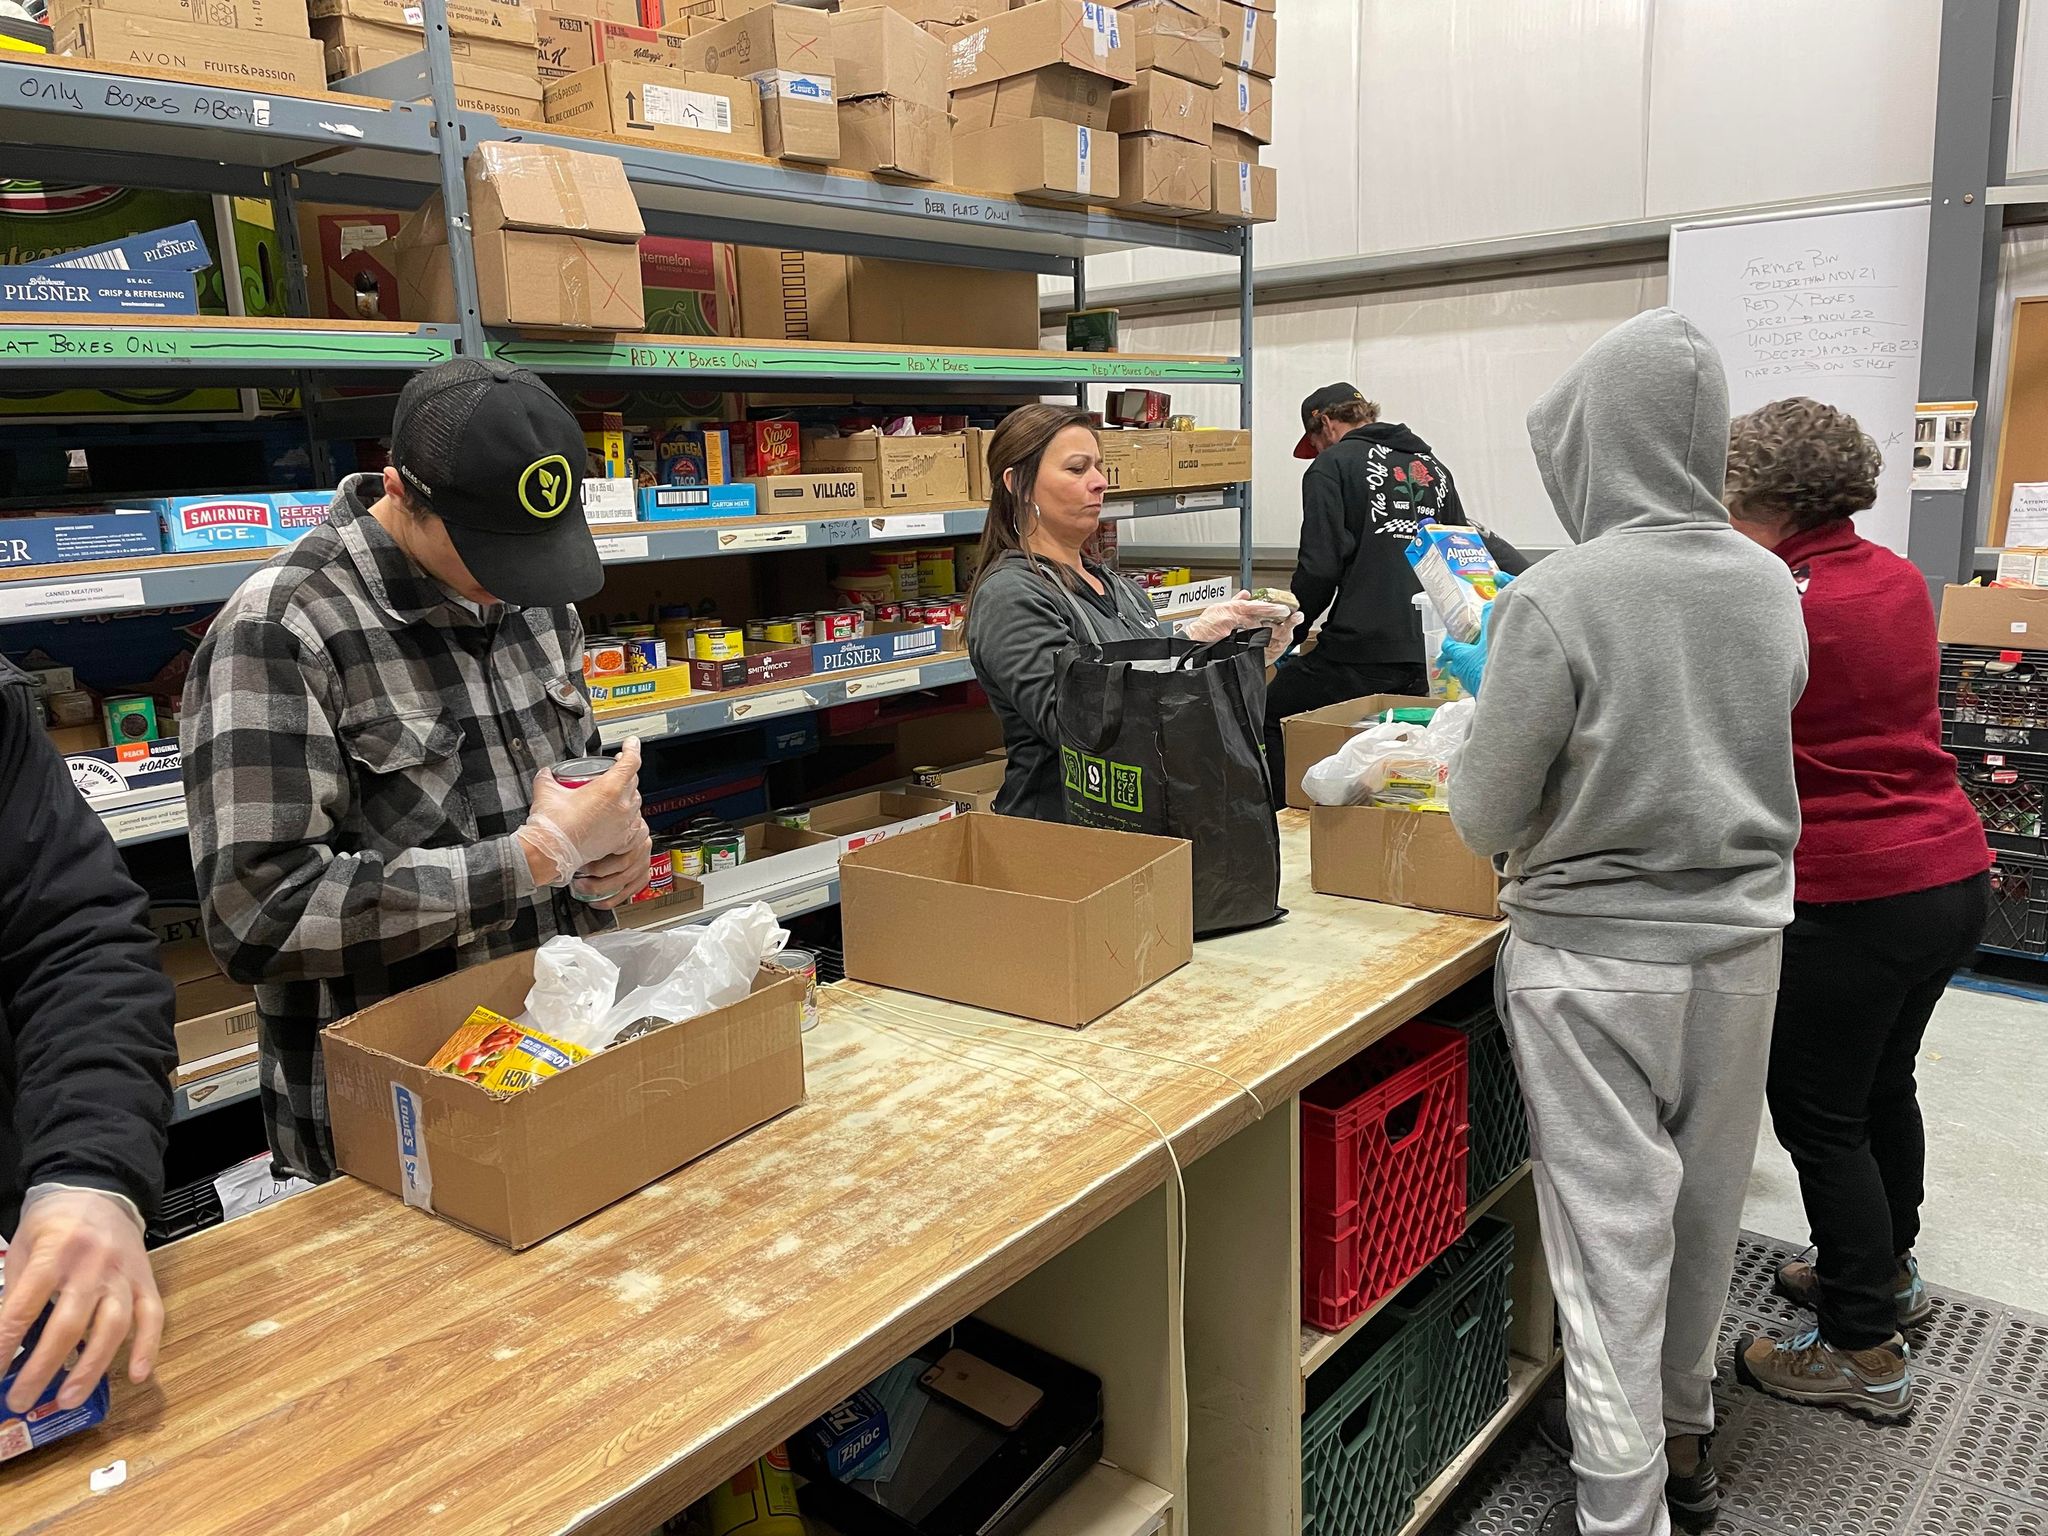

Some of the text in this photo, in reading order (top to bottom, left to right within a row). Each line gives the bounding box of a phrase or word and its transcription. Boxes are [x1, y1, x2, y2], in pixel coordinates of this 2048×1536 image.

[456, 13, 489, 24] download
[129, 50, 186, 67] AVON
[925, 197, 1010, 221] BEER FLATS ONLY
[143, 240, 198, 262] PILSNER
[640, 252, 691, 267] atermelon
[3, 284, 185, 302] PILSNER CRISP & REFRESHING
[1743, 297, 1779, 313] RED
[1784, 293, 1803, 311] X
[0, 334, 176, 355] AT BOXES ONLY
[1748, 332, 1803, 348] UNDER
[631, 348, 657, 367] RED
[689, 352, 726, 369] BOXES
[733, 354, 758, 368] ONLY
[907, 358, 925, 371] RED
[771, 443, 788, 459] Top
[812, 482, 856, 498] VILLAGE
[190, 506, 329, 525] SMIRNOFF REFRE
[1416, 505, 1435, 516] 1966
[1447, 547, 1487, 561] Almond
[1459, 556, 1487, 567] Breeze
[45, 587, 103, 598] CANNED MEAT/FISH
[1178, 585, 1225, 605] muddlers
[823, 647, 881, 670] PILSNER
[748, 660, 788, 675] SMITHWICK'S
[123, 750, 145, 758] PEACH
[150, 744, 179, 754] ORIGINAL
[72, 763, 118, 784] ON SUNDAY
[643, 795, 700, 817] RMELONS
[500, 1069, 532, 1089] NCH
[839, 1424, 882, 1462] Ziploc
